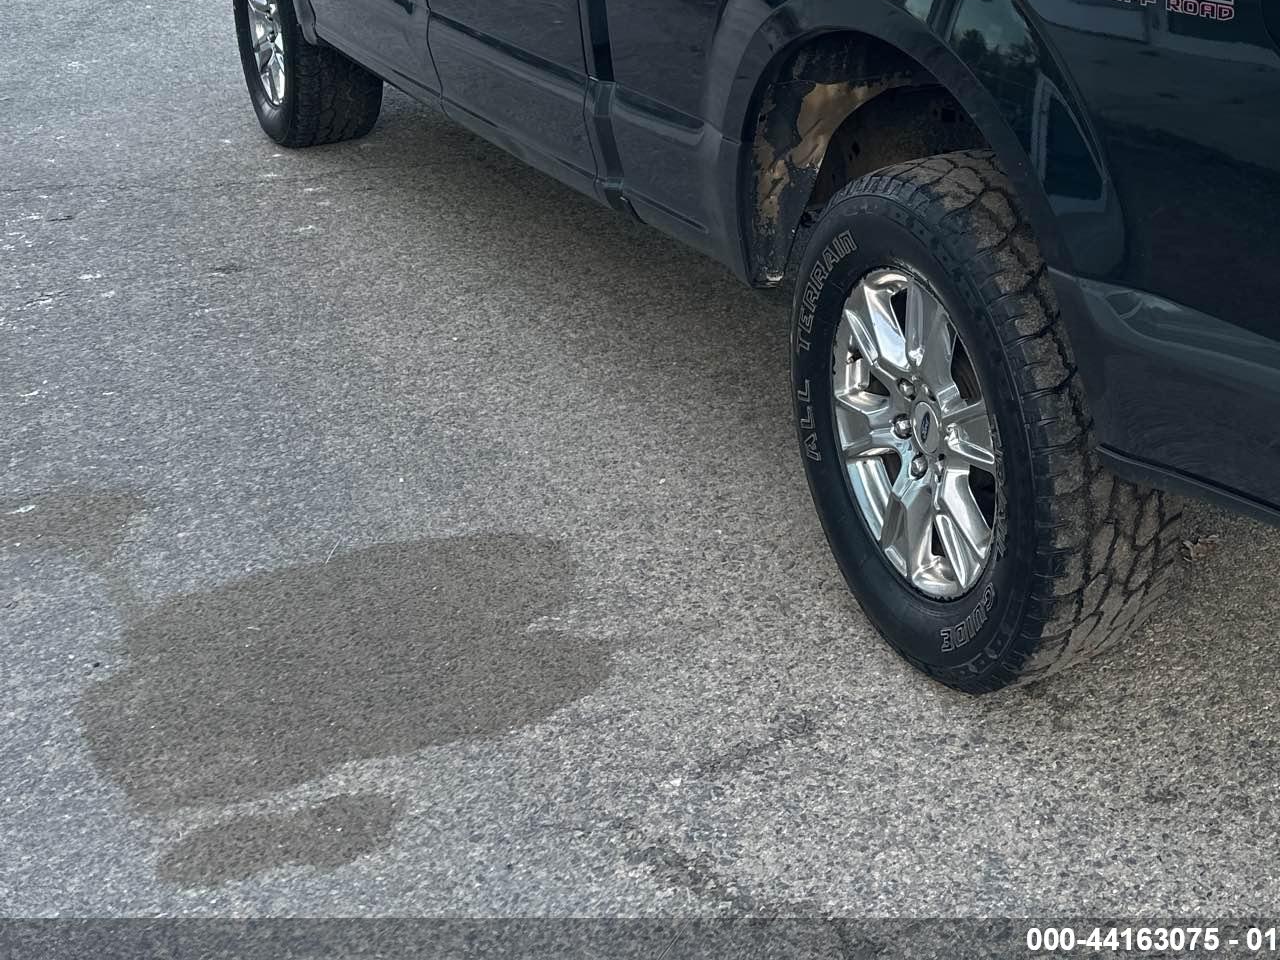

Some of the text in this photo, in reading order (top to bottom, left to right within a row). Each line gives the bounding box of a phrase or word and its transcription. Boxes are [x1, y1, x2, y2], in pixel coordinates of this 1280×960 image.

[797, 230, 858, 462] ALL TERRAIN
[940, 582, 996, 653] GUIDE
